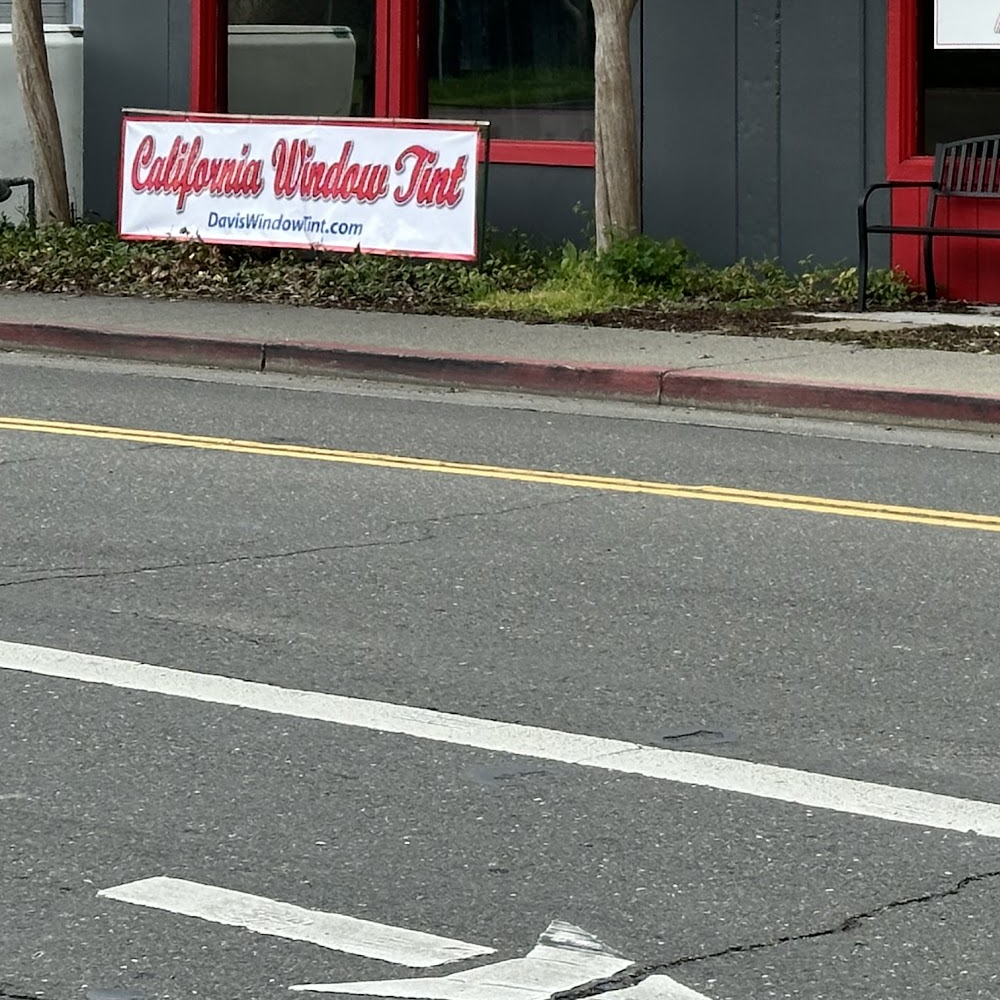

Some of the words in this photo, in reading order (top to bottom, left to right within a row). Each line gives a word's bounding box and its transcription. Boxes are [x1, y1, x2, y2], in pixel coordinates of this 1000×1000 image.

[131, 134, 264, 214] California
[271, 138, 389, 204] Window
[394, 145, 467, 208] Tint
[208, 211, 363, 236] DavisWindowTint.com
